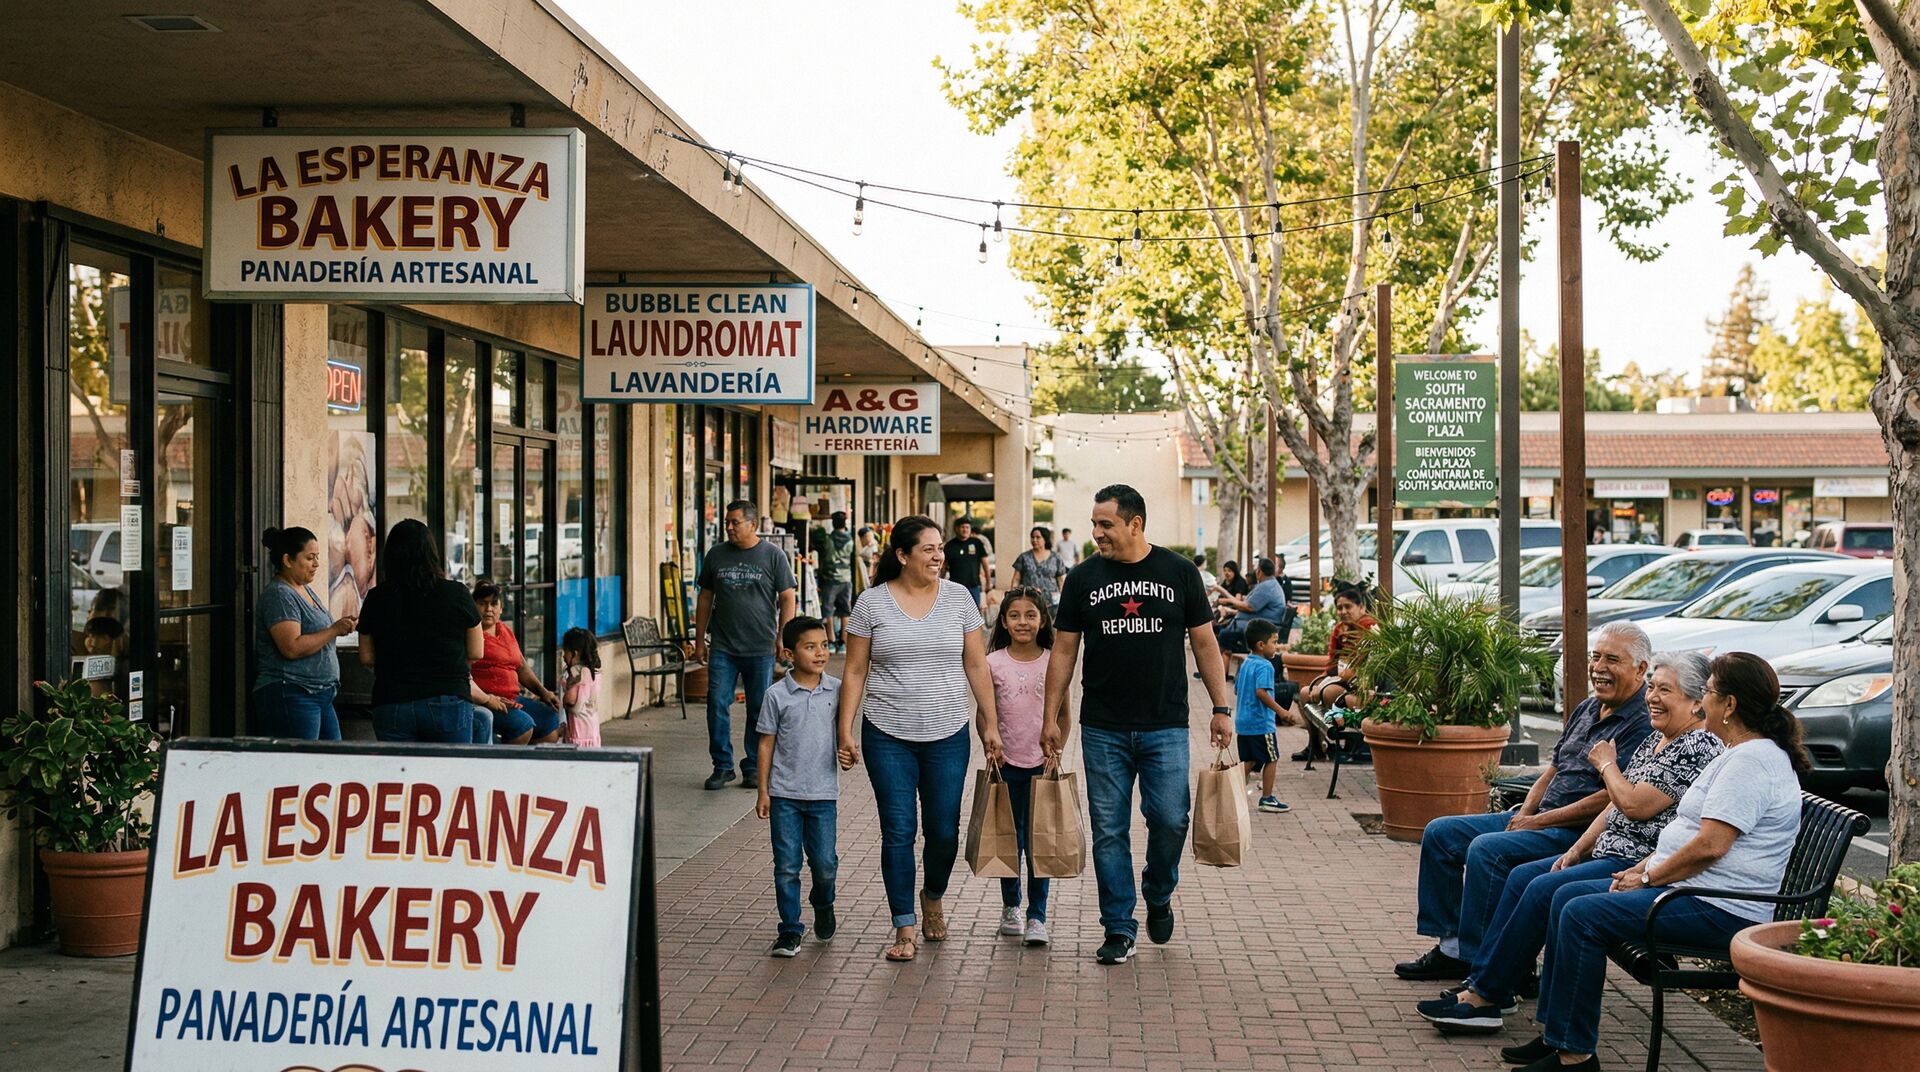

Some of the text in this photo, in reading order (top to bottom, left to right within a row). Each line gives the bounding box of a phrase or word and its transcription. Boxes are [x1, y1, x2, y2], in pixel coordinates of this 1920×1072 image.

[228, 144, 550, 201] LA ESPERANZA
[256, 195, 527, 252] BAKERY
[241, 256, 539, 284] PANADERÍA ARTESANAL
[605, 293, 787, 314] BUBBLE CLEAN
[591, 319, 802, 357] LAUNDROMAT
[610, 367, 782, 393] LAVANDERÍA
[1414, 370, 1477, 380] WELCOME TO
[1425, 383, 1465, 395] SOUTH
[822, 389, 919, 412] A&G
[1405, 397, 1487, 410] SACRAMENTO
[805, 416, 932, 434] HARDWARE
[1408, 411, 1483, 423] COMMUNITY
[1427, 425, 1465, 437] PLAZA
[824, 436, 919, 451] FERRETERÍA
[1415, 447, 1477, 457] BIENVENIDOS
[1420, 459, 1471, 468] A LA PLAZA
[1406, 469, 1485, 479] COMUNITARIA DE
[1398, 480, 1494, 490] SOUTH SACRAMENTO
[1089, 580, 1175, 606] SACRAMENTO
[1102, 617, 1163, 635] REPUBLIC
[174, 781, 607, 891] LA ESPERANZA
[225, 882, 540, 972] BAKERY
[155, 979, 599, 1055] PANADERÍA ARTESANAL
